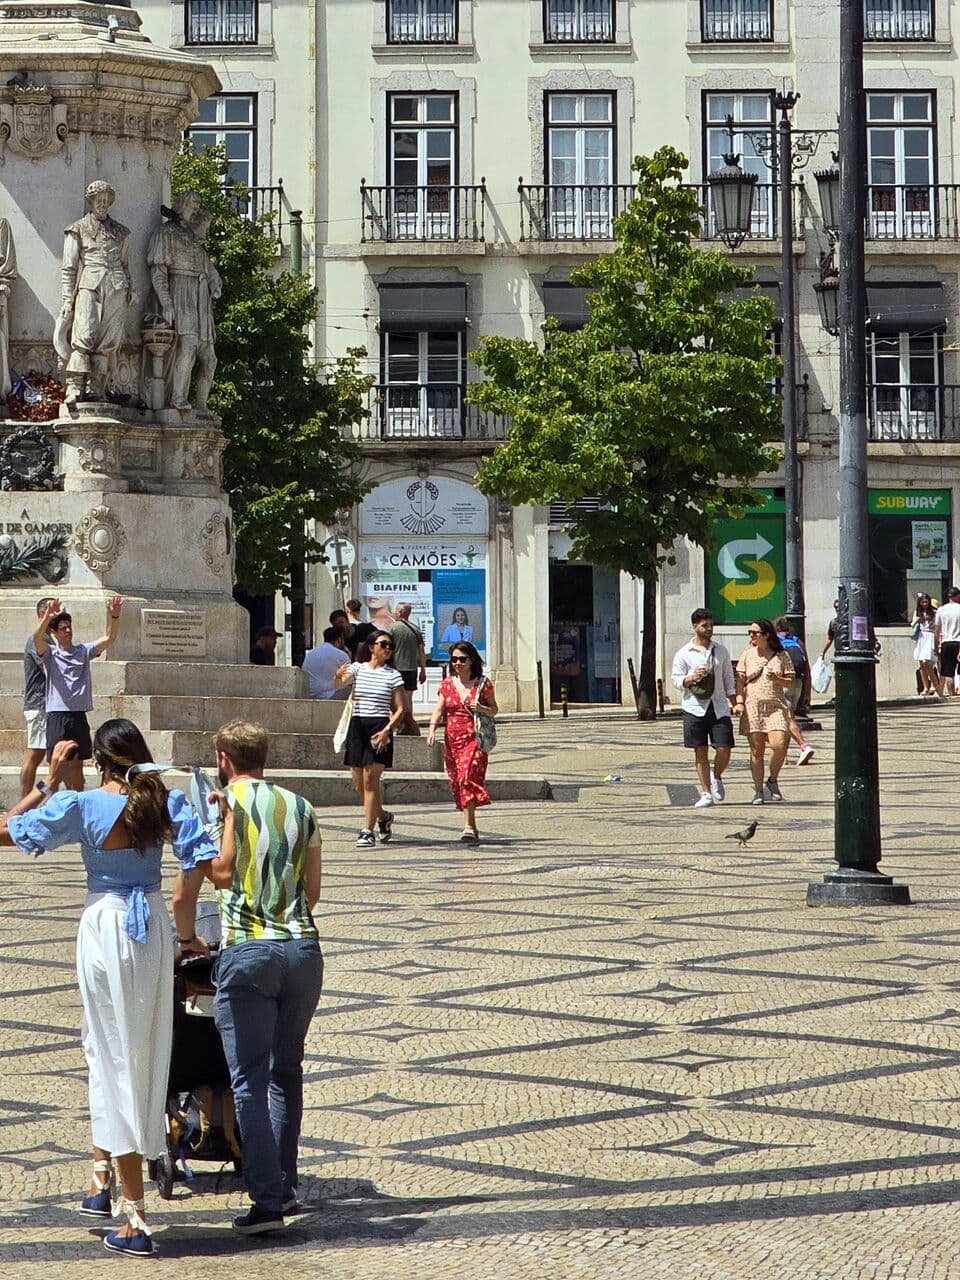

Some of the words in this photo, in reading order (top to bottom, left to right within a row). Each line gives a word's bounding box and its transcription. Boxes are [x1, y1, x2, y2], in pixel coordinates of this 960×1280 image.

[876, 496, 942, 509] SUBWAY
[20, 508, 30, 520] A
[6, 522, 23, 535] DE
[389, 551, 457, 567] CAMÕES
[373, 584, 418, 592] BIAFINE
